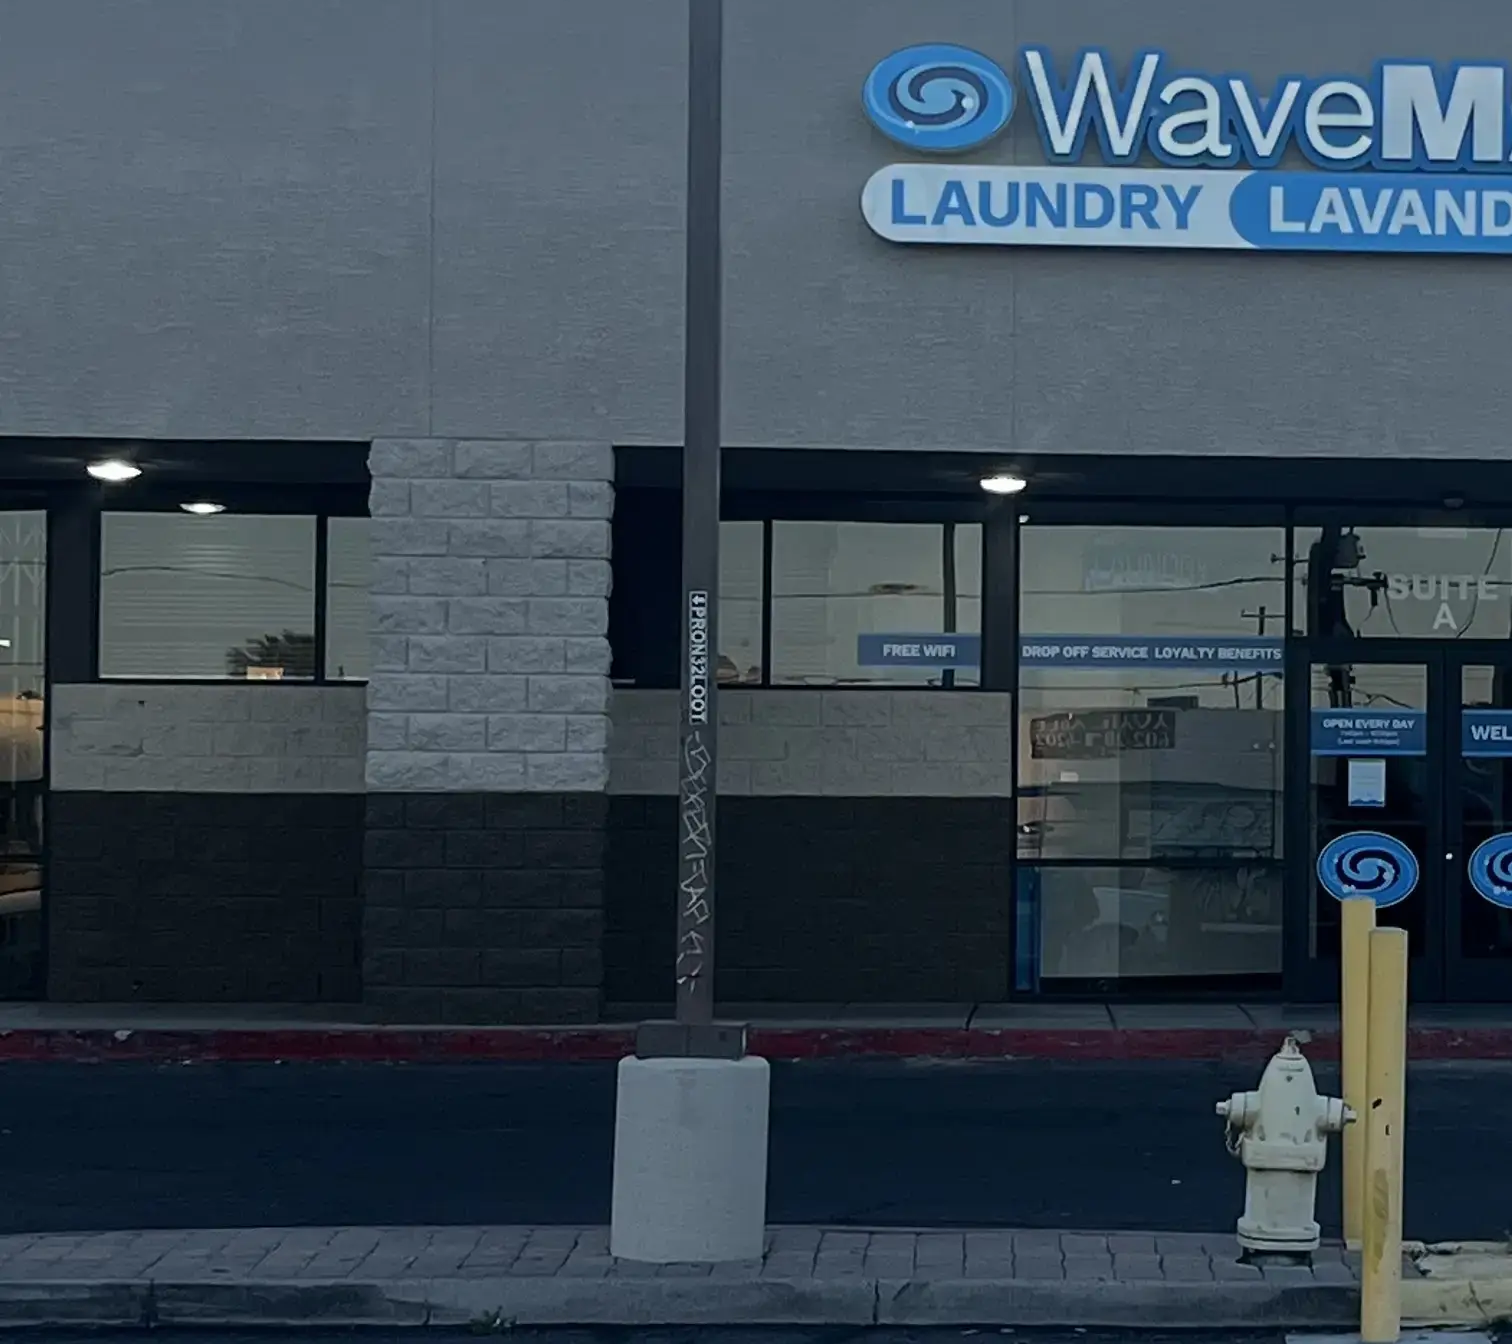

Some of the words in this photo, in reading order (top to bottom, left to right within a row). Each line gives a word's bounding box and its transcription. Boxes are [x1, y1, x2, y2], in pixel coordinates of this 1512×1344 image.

[890, 178, 1203, 231] LAUNDRY
[1388, 573, 1499, 601] SUITE
[1432, 602, 1458, 630] A
[882, 644, 920, 657] FREE
[922, 644, 955, 657] WIFI
[1022, 645, 1060, 658] DROP
[1062, 645, 1090, 658] OFF
[1091, 646, 1149, 659] SERVICE
[1154, 646, 1216, 659] LOYALTY
[1217, 647, 1283, 660] BENEFITS
[1322, 718, 1354, 729] OPEN
[1354, 718, 1391, 729] EVERY
[1391, 718, 1416, 729] DAY
